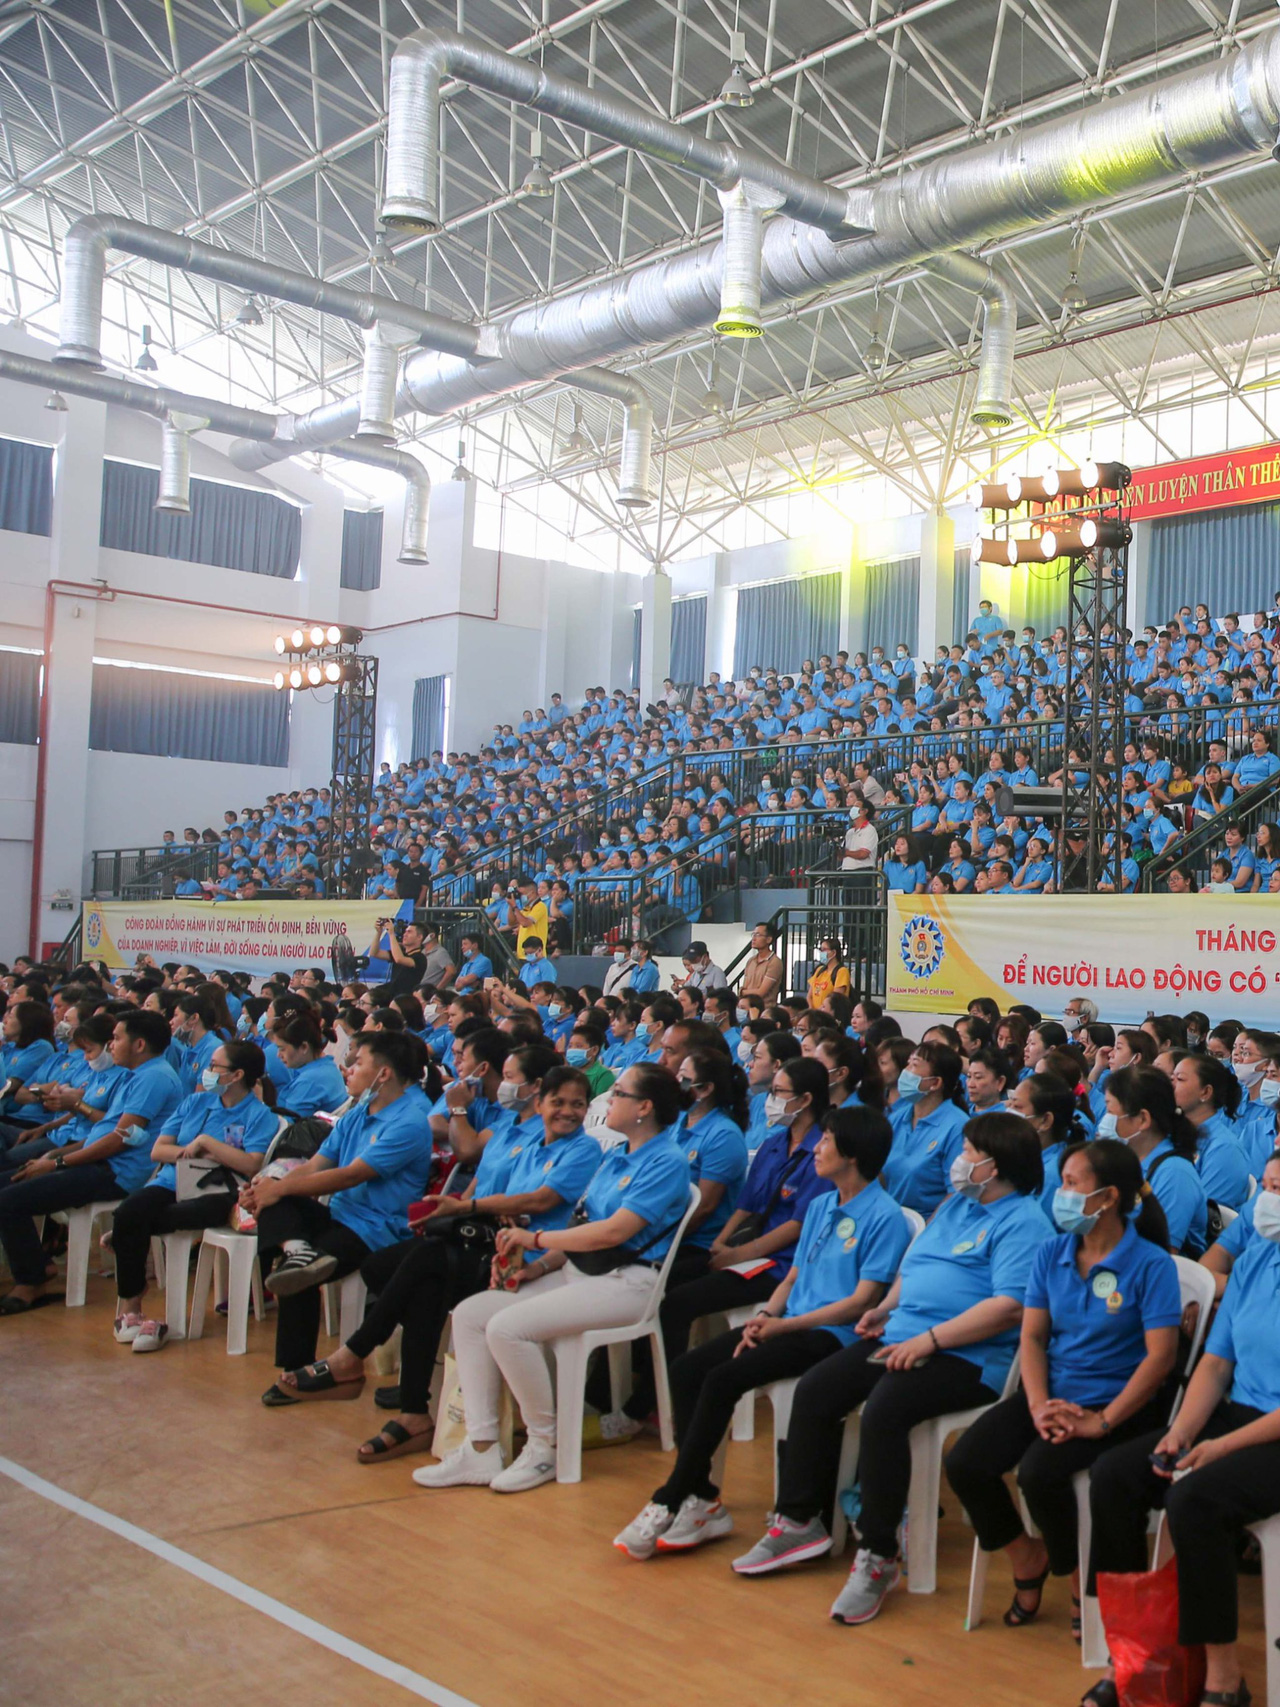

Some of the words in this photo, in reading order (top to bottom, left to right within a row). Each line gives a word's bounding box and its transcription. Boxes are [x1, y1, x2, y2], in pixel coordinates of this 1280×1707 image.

[1148, 473, 1199, 504] LUYỆN
[1202, 461, 1246, 494] THÂN
[131, 939, 154, 951] DOANH
[308, 945, 325, 959] LAO
[1195, 923, 1277, 953] THÁNG
[1003, 953, 1028, 985] ĐỂ
[1032, 960, 1098, 988] NGƯỜI
[1105, 967, 1146, 989] LAO
[1153, 963, 1222, 997] ĐỘNG
[1229, 965, 1267, 994] CÓ
